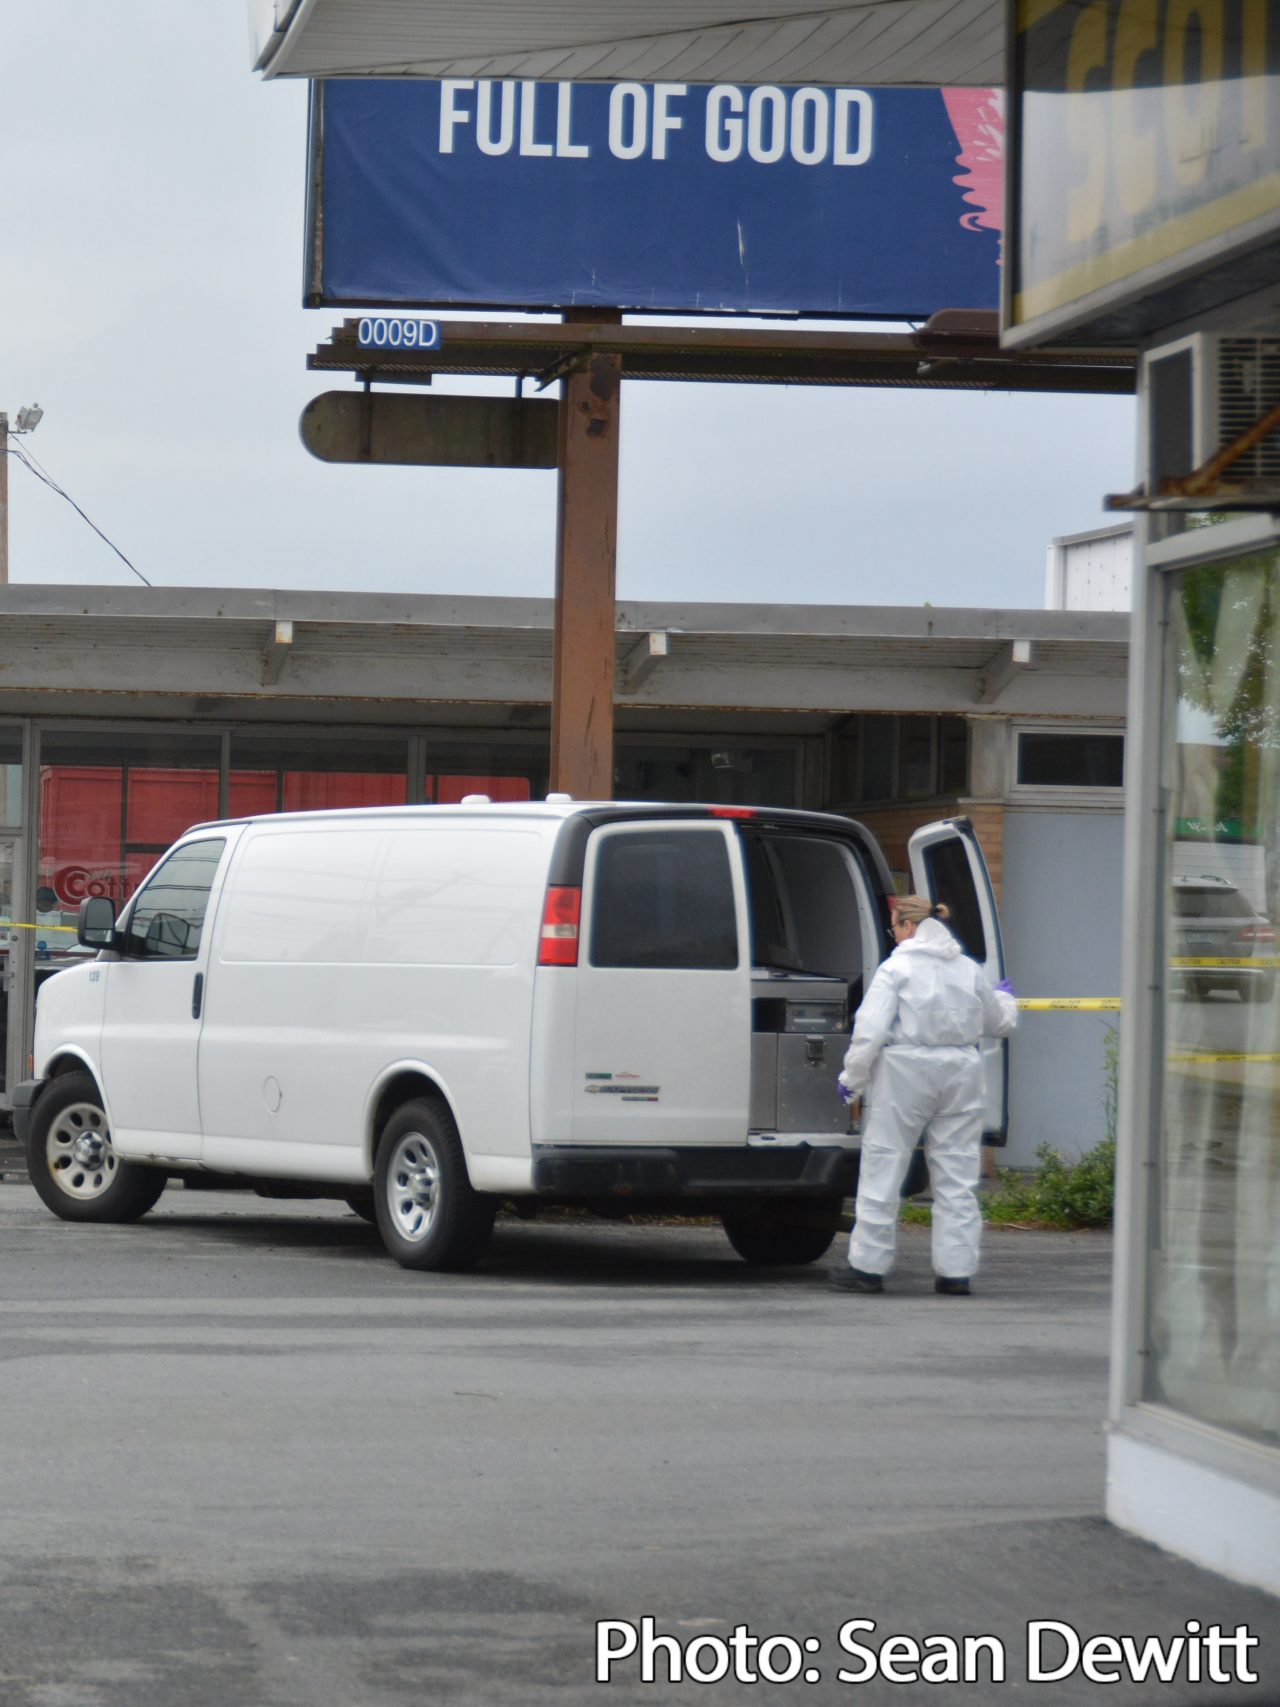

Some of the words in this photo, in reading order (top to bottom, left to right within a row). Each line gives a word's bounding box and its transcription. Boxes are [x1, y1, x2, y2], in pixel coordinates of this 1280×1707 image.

[439, 80, 588, 158] FULL
[608, 82, 683, 160] OF
[704, 84, 874, 167] GOOD
[358, 318, 437, 347] 0009D
